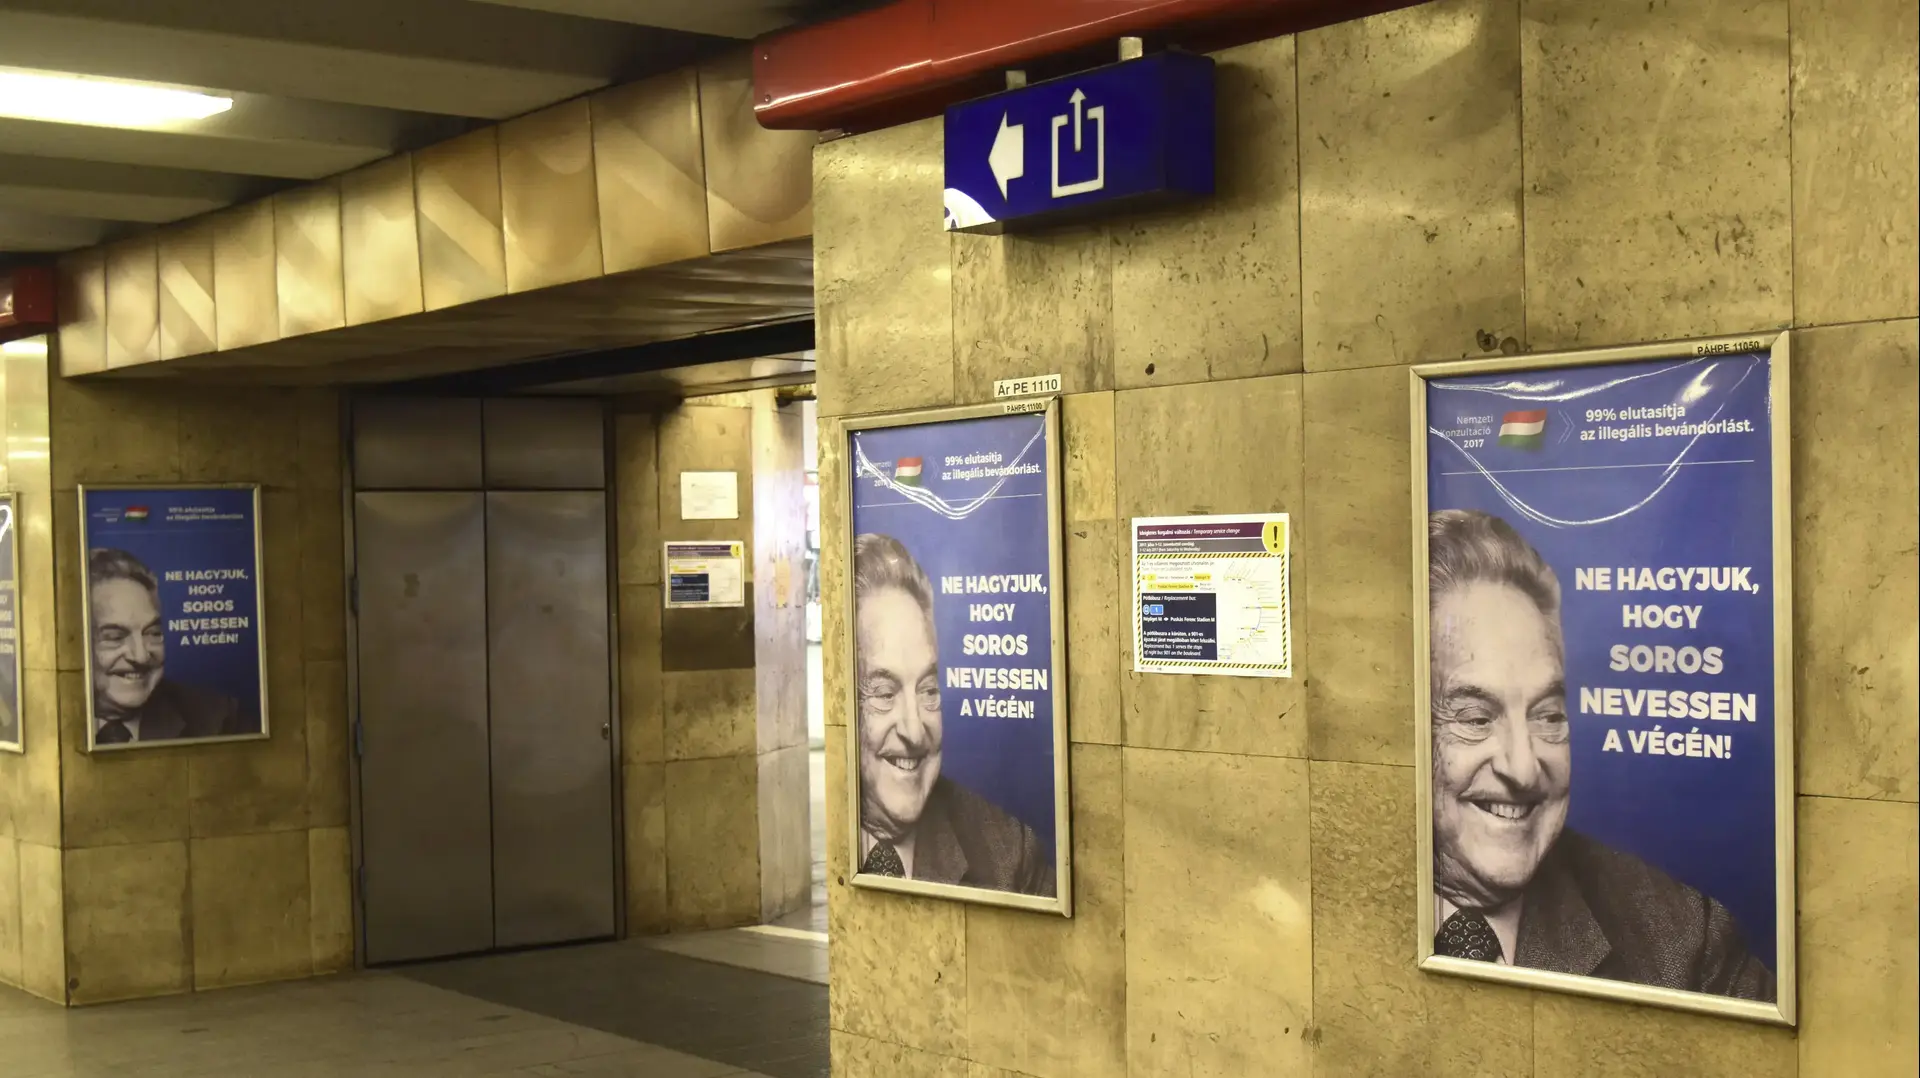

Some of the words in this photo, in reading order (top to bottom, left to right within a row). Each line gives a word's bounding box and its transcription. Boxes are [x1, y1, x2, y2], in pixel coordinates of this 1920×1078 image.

[1697, 344, 1730, 356] PÁHPE
[1733, 340, 1760, 351] 11050
[998, 382, 1010, 396] Ár
[1013, 382, 1028, 394] PE
[1032, 378, 1058, 392] 1110
[1027, 402, 1042, 410] 11100
[1586, 408, 1616, 422] 99%
[1619, 404, 1686, 420] elutasítja
[1456, 414, 1494, 424] Nemzeti
[1580, 430, 1596, 441] az
[1598, 424, 1652, 442] illegális
[1655, 418, 1754, 437] bevándorlást.
[1464, 438, 1484, 448] 2017
[944, 456, 964, 466] 99%
[964, 452, 1002, 465] elutasítja
[942, 472, 952, 480] az
[952, 467, 984, 481] illegális
[984, 463, 1042, 477] bevándorlást.
[165, 571, 183, 581] NE
[185, 568, 248, 581] HAGYJUK,
[1575, 567, 1611, 591] NE
[1617, 567, 1760, 594] HAGYJUK,
[188, 584, 224, 595] HOGY
[941, 576, 963, 594] NE
[966, 574, 1048, 594] HAGYJUK,
[183, 599, 234, 613] SOROS
[969, 603, 1015, 622] HOGY
[168, 616, 249, 631] NEVESSEN
[1622, 604, 1703, 629] HOGY
[180, 635, 190, 646] A
[192, 631, 239, 645] VÉGÉN!
[962, 634, 1028, 656] SOROS
[1609, 644, 1724, 674] SOROS
[946, 667, 1048, 690] NEVESSEN
[960, 699, 972, 716] A
[974, 695, 1035, 719] VÉGÉN!
[1580, 687, 1756, 722] NEVESSEN
[1602, 728, 1624, 752] A
[1628, 725, 1732, 759] VÉGÉN!
